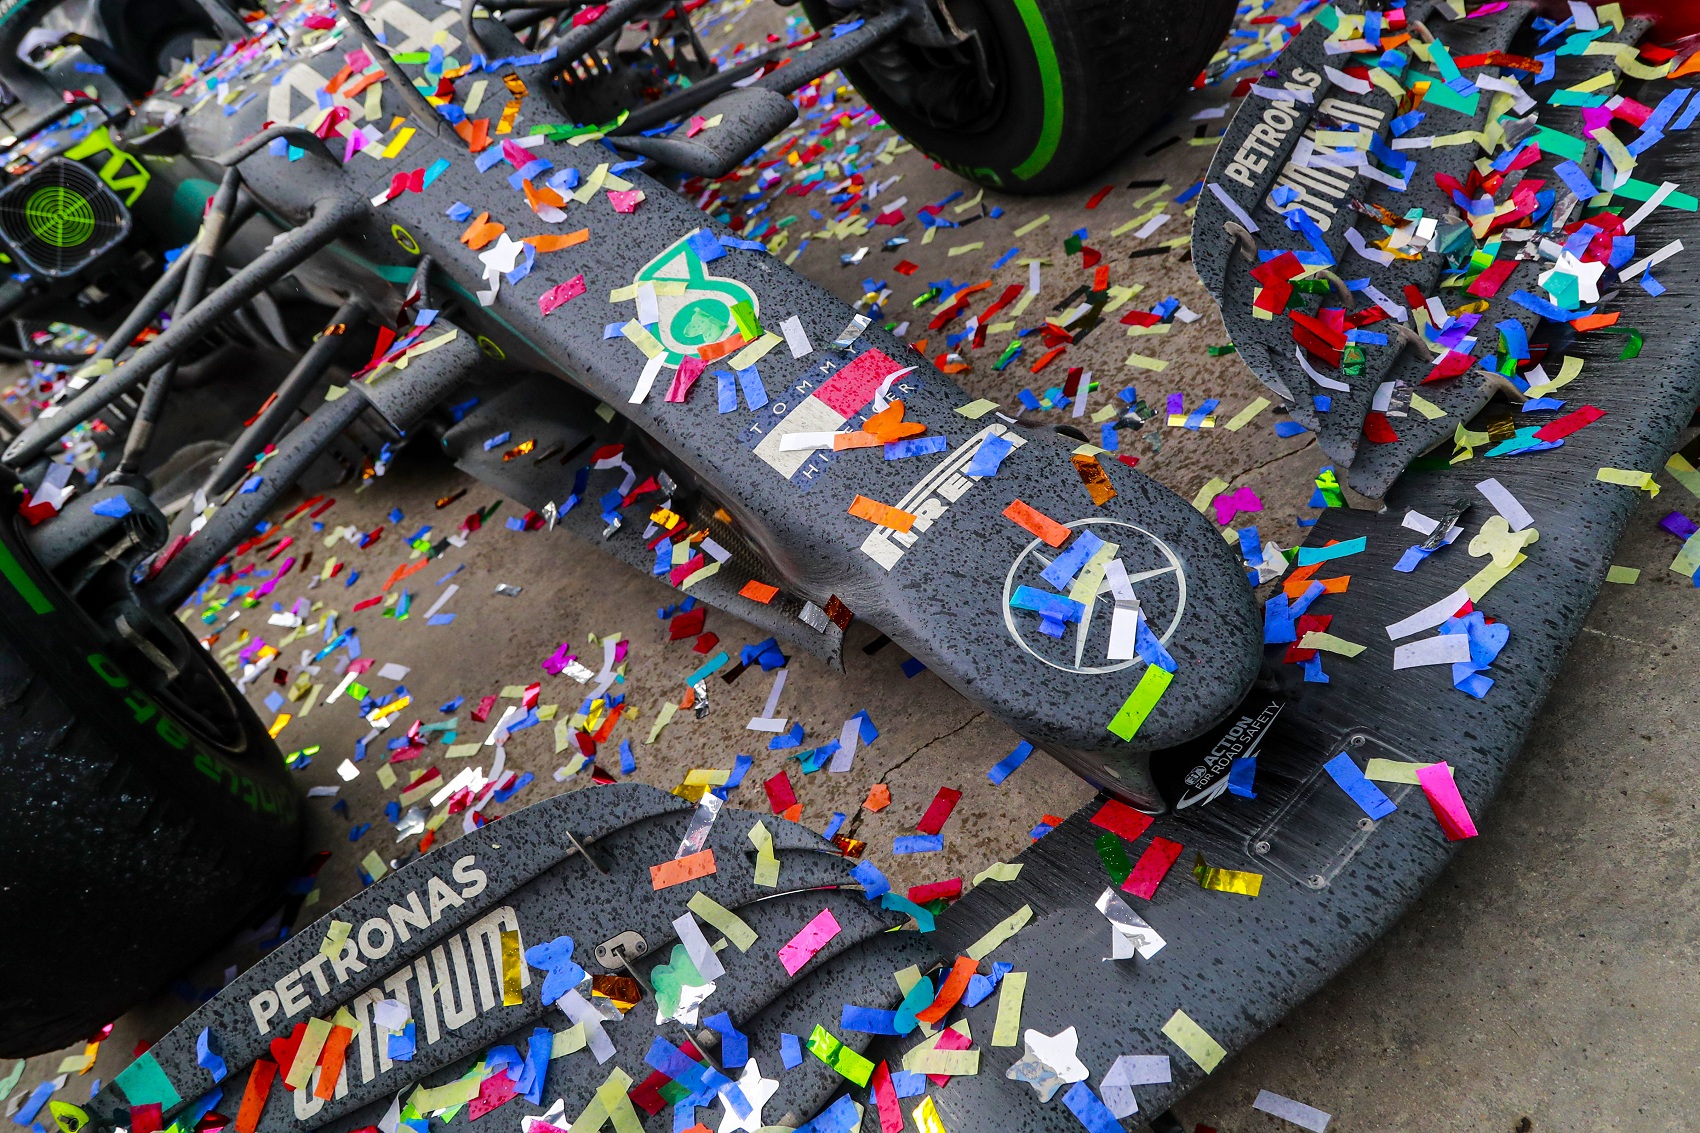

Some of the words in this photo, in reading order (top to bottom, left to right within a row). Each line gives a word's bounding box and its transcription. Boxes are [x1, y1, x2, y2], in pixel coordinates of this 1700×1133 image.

[1185, 766, 1206, 785] FIA
[1203, 715, 1255, 767] ACTION
[1195, 773, 1214, 790] FOR
[1211, 743, 1243, 775] ROAD
[1240, 701, 1280, 744] SAFETY
[249, 855, 488, 1036] PETRONAS
